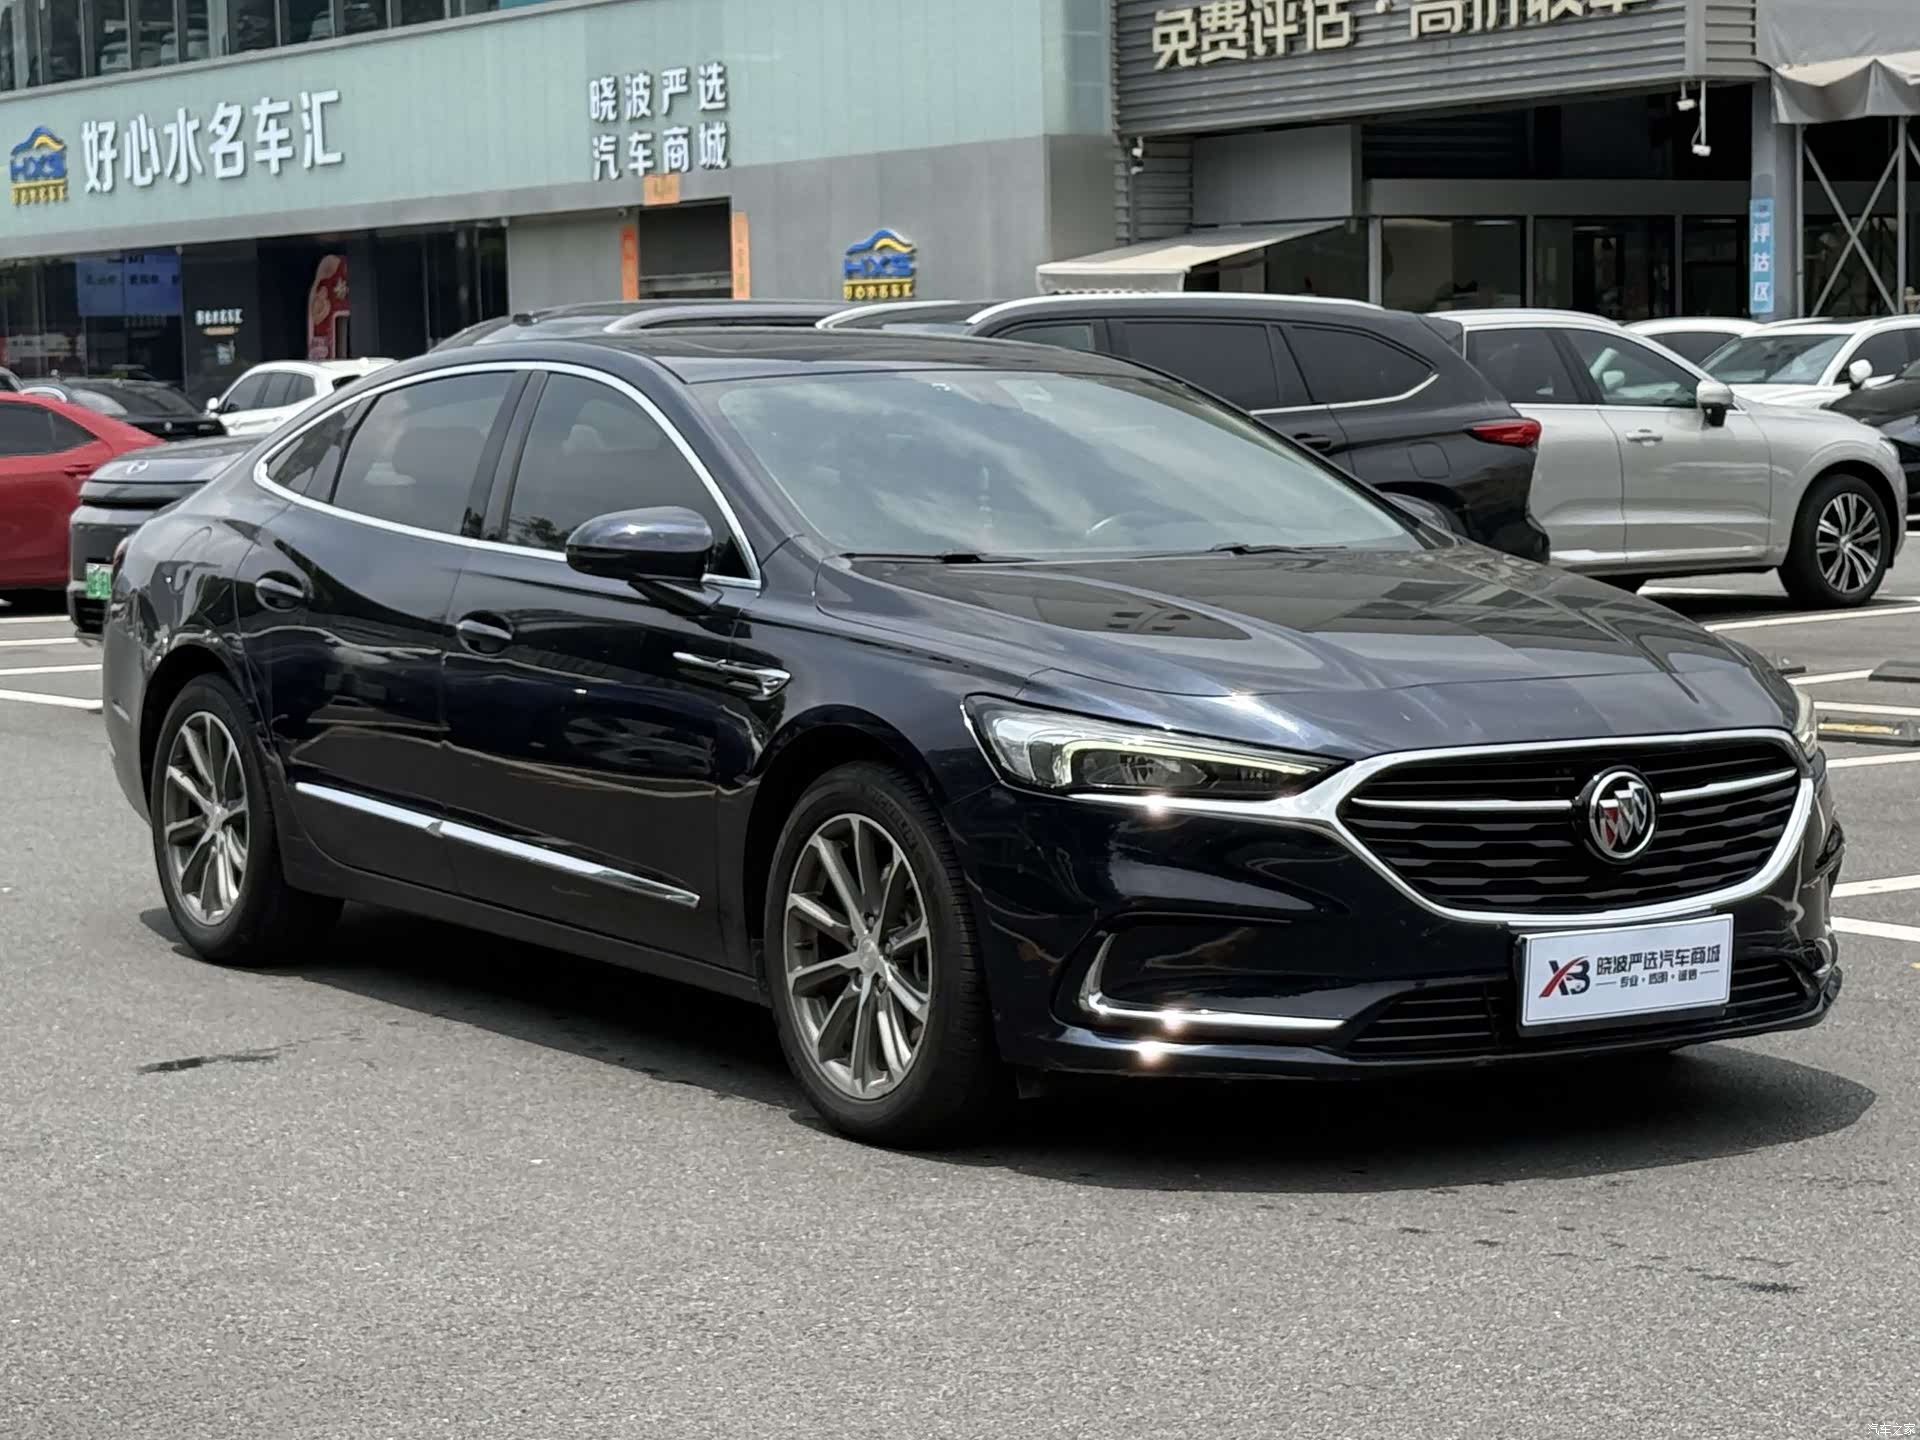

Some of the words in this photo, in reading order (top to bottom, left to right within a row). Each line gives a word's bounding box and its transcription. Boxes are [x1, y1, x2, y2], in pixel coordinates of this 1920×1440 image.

[589, 62, 727, 122] 晓波严选
[82, 89, 343, 194] 好心水名车汇
[592, 121, 728, 181] 汽车商城
[1538, 955, 1591, 998] XB
[1596, 944, 1721, 976] 晓波严选汽车商城
